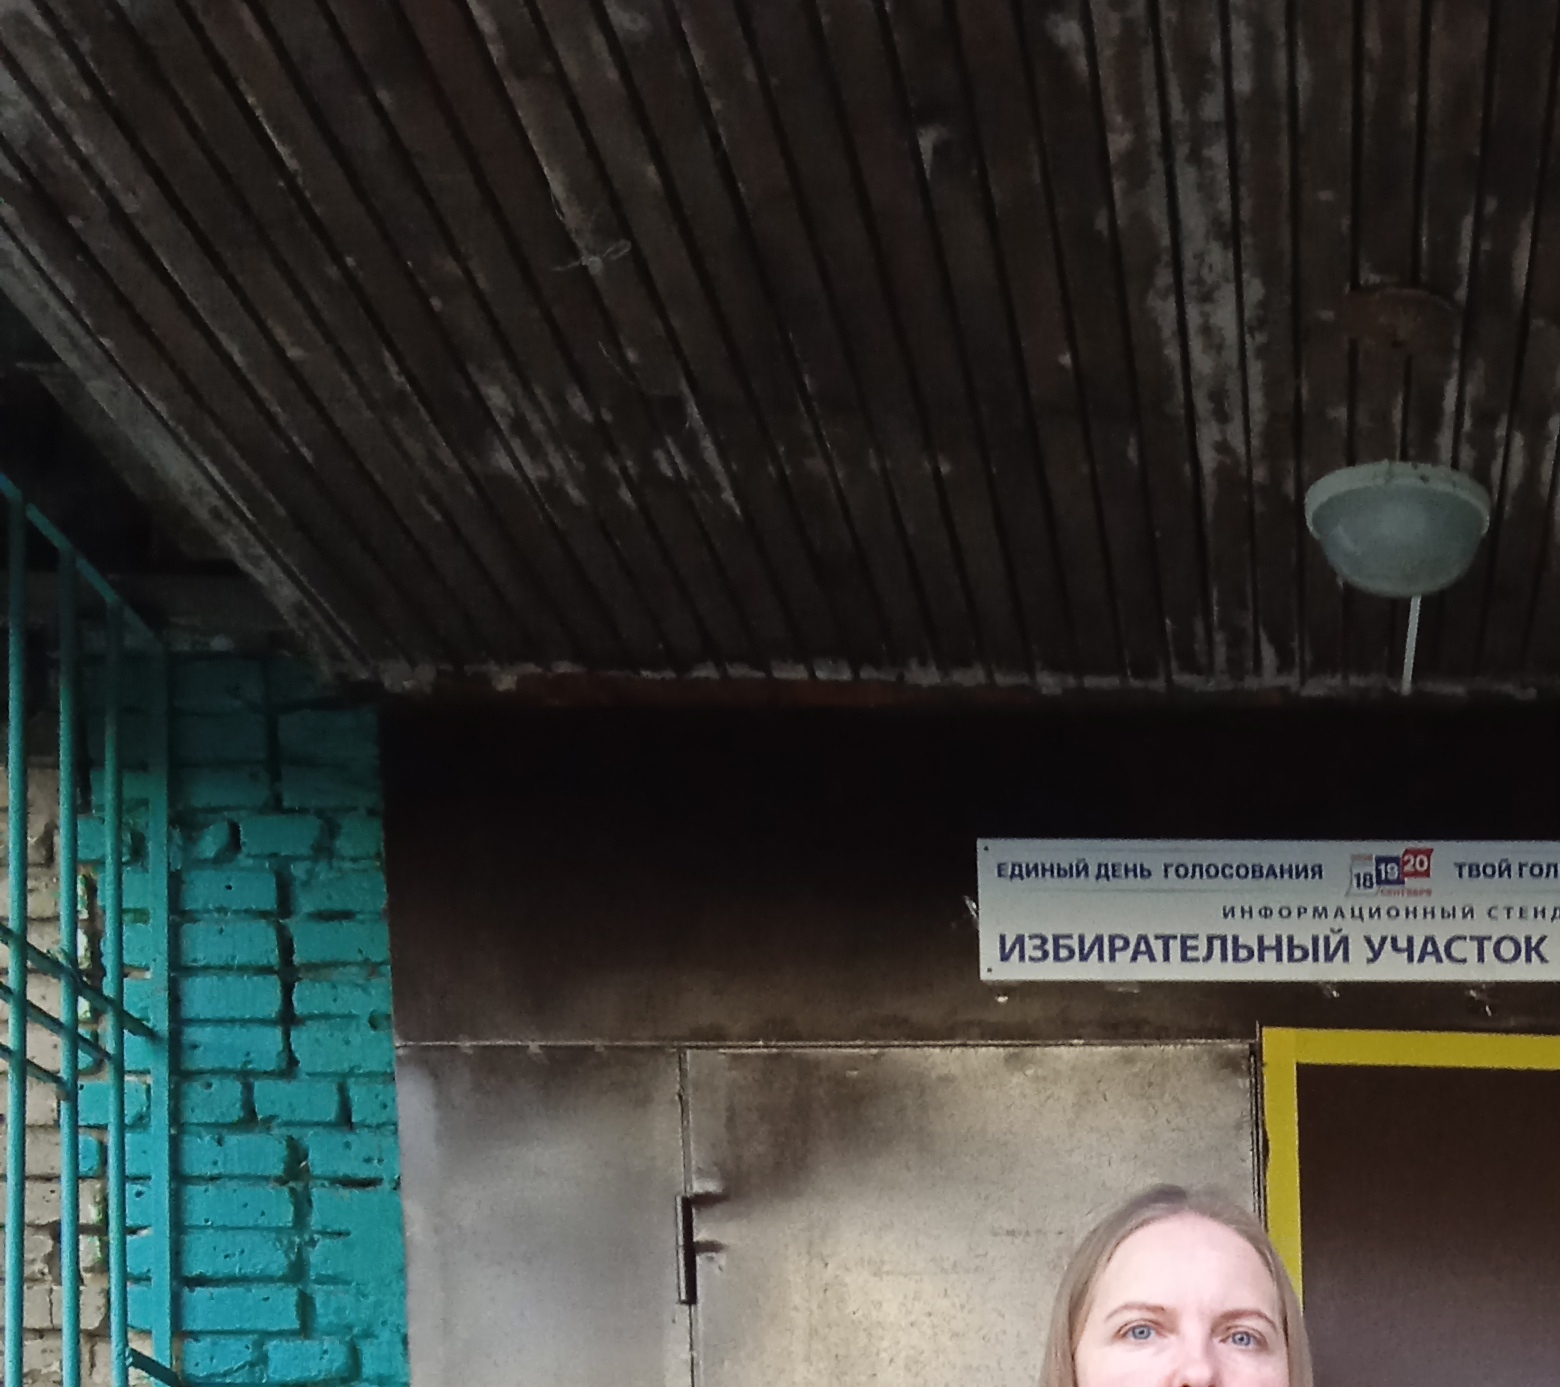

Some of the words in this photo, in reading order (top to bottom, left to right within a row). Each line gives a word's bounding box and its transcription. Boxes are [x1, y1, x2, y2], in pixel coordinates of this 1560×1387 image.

[997, 858, 1089, 881] ЕДИНЫЙ
[1095, 862, 1152, 881] ДЕНЬ
[1163, 862, 1323, 880] ГОЛОСОВАНИЯ
[1354, 872, 1374, 889] 18
[1403, 854, 1428, 872] 20
[1454, 859, 1511, 879] ТВОЙ
[1222, 904, 1475, 922] ИНФОРМАЦИОННЫЙ
[999, 927, 1350, 964] ИЗБИРАТЕЛЬНЫЙ
[1364, 934, 1549, 965] УЧАСТОК
